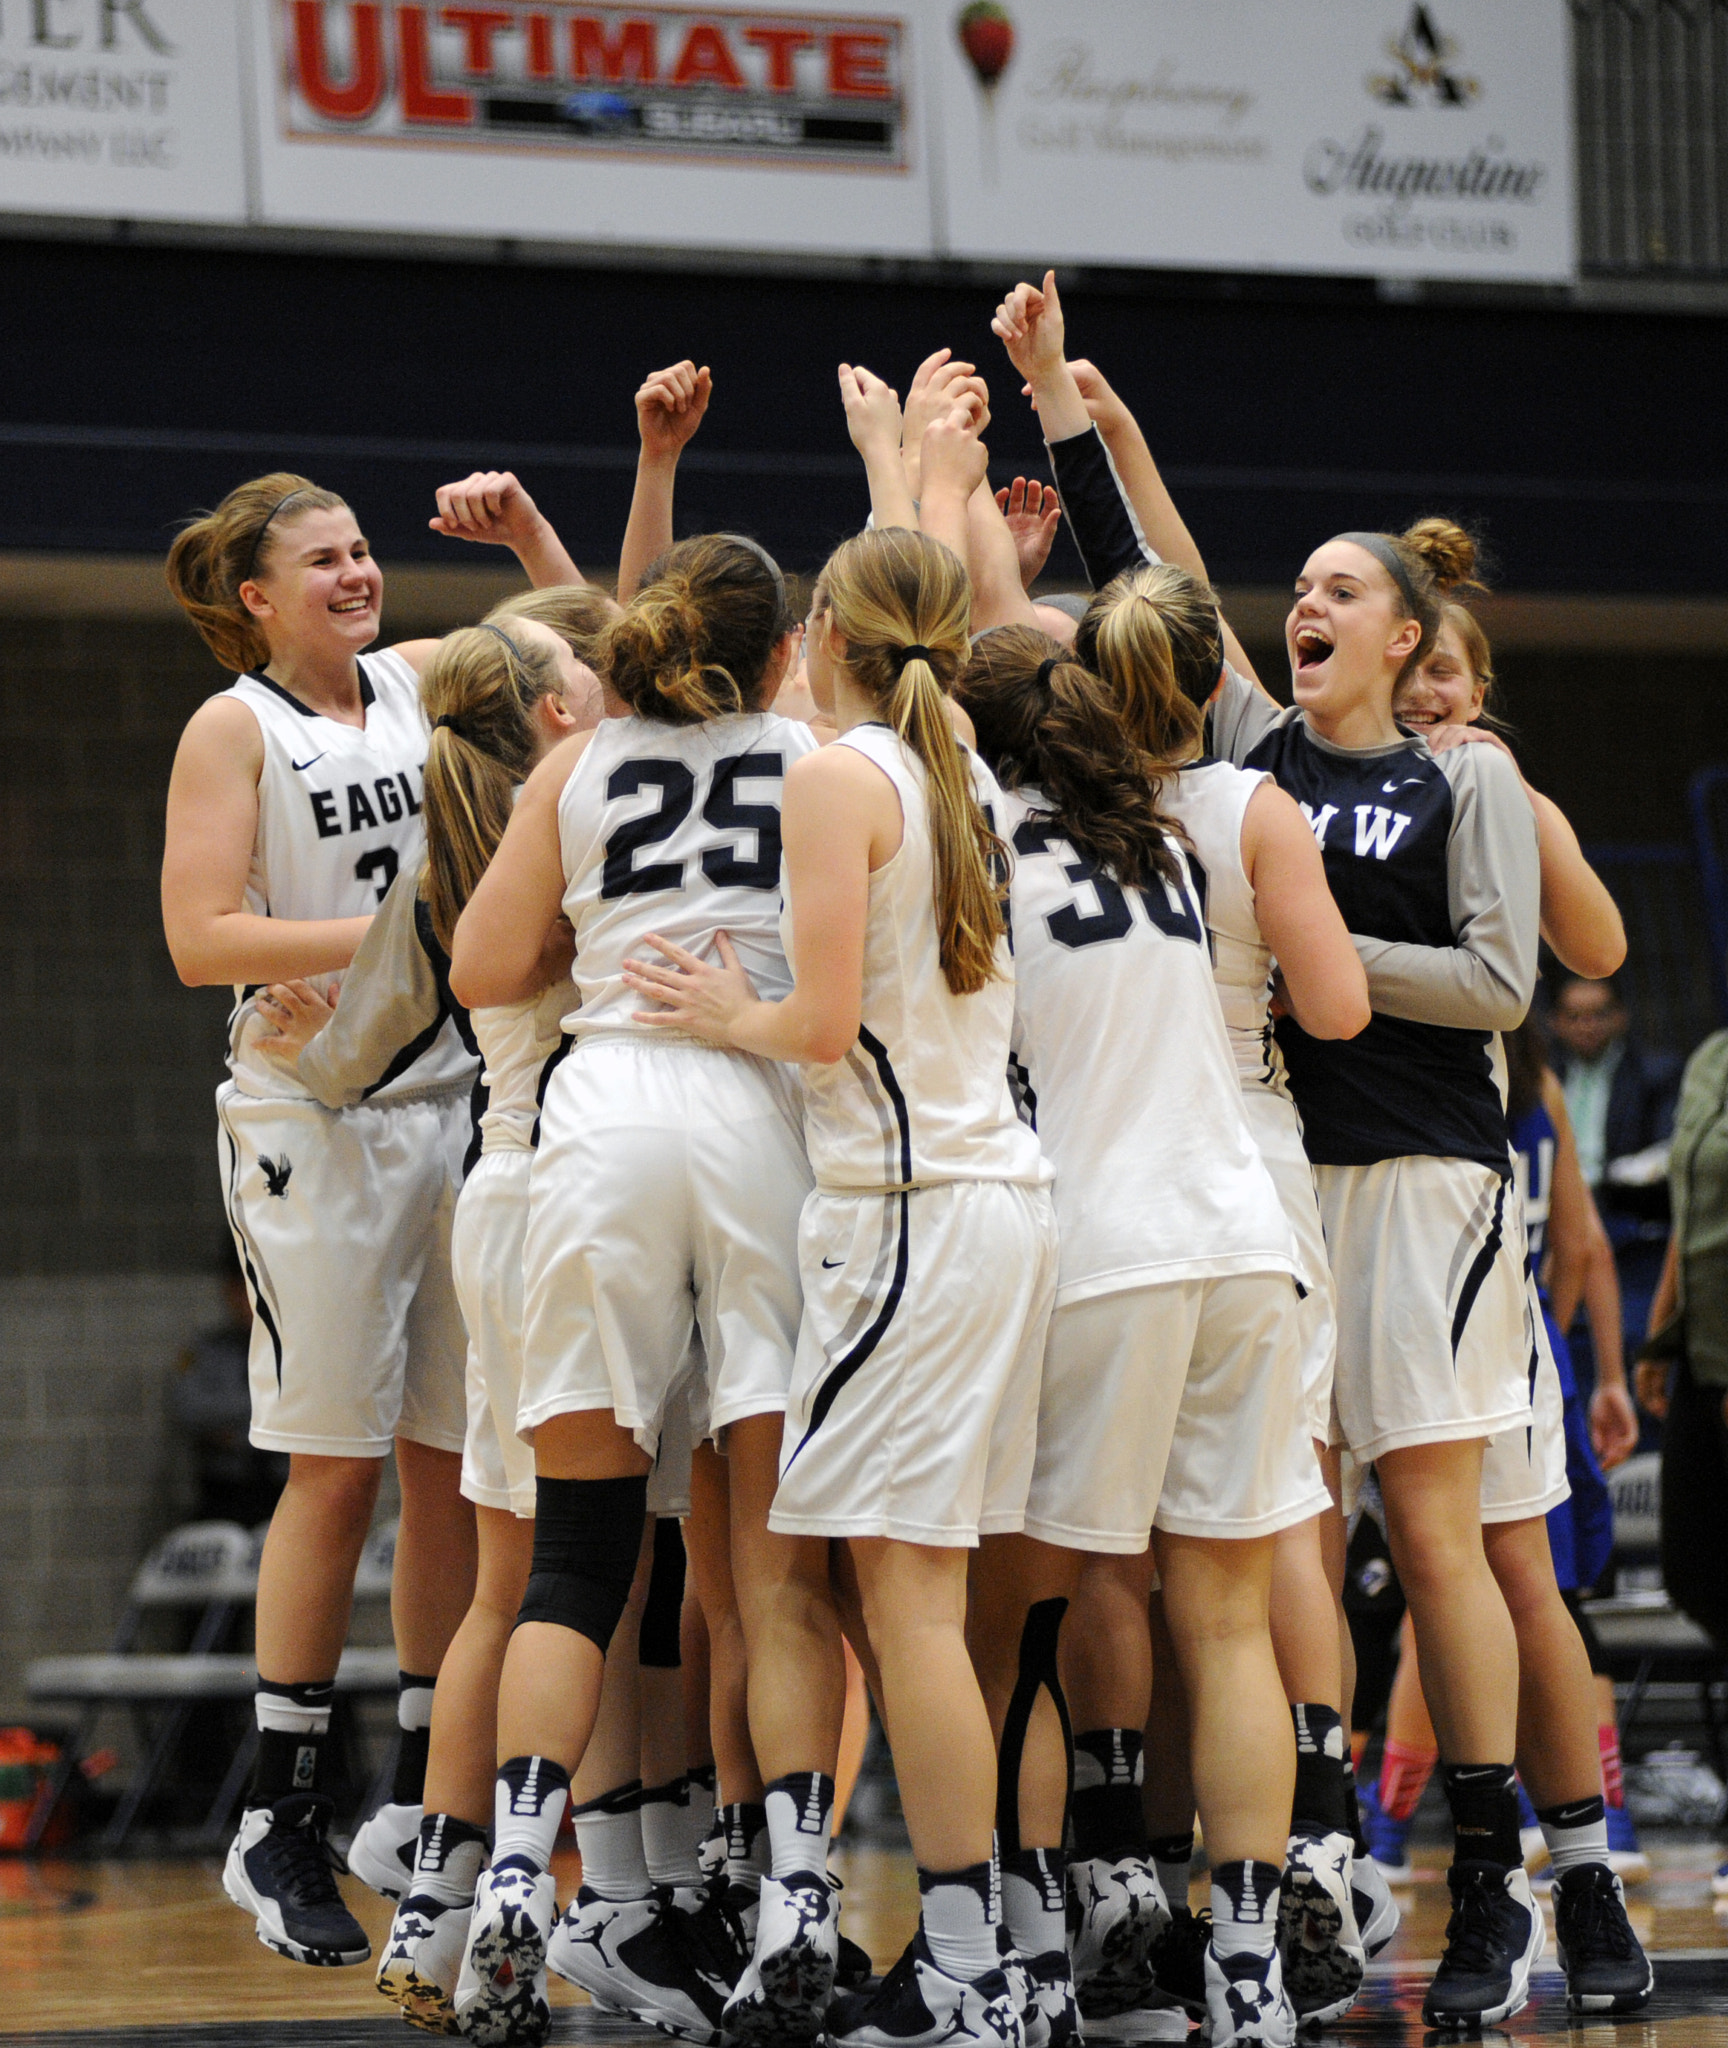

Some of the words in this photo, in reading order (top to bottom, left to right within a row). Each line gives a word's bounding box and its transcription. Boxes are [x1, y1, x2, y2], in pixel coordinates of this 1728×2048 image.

[288, 0, 893, 127] ULTIMATE
[600, 750, 786, 901] 25
[1010, 817, 1203, 953] 30
